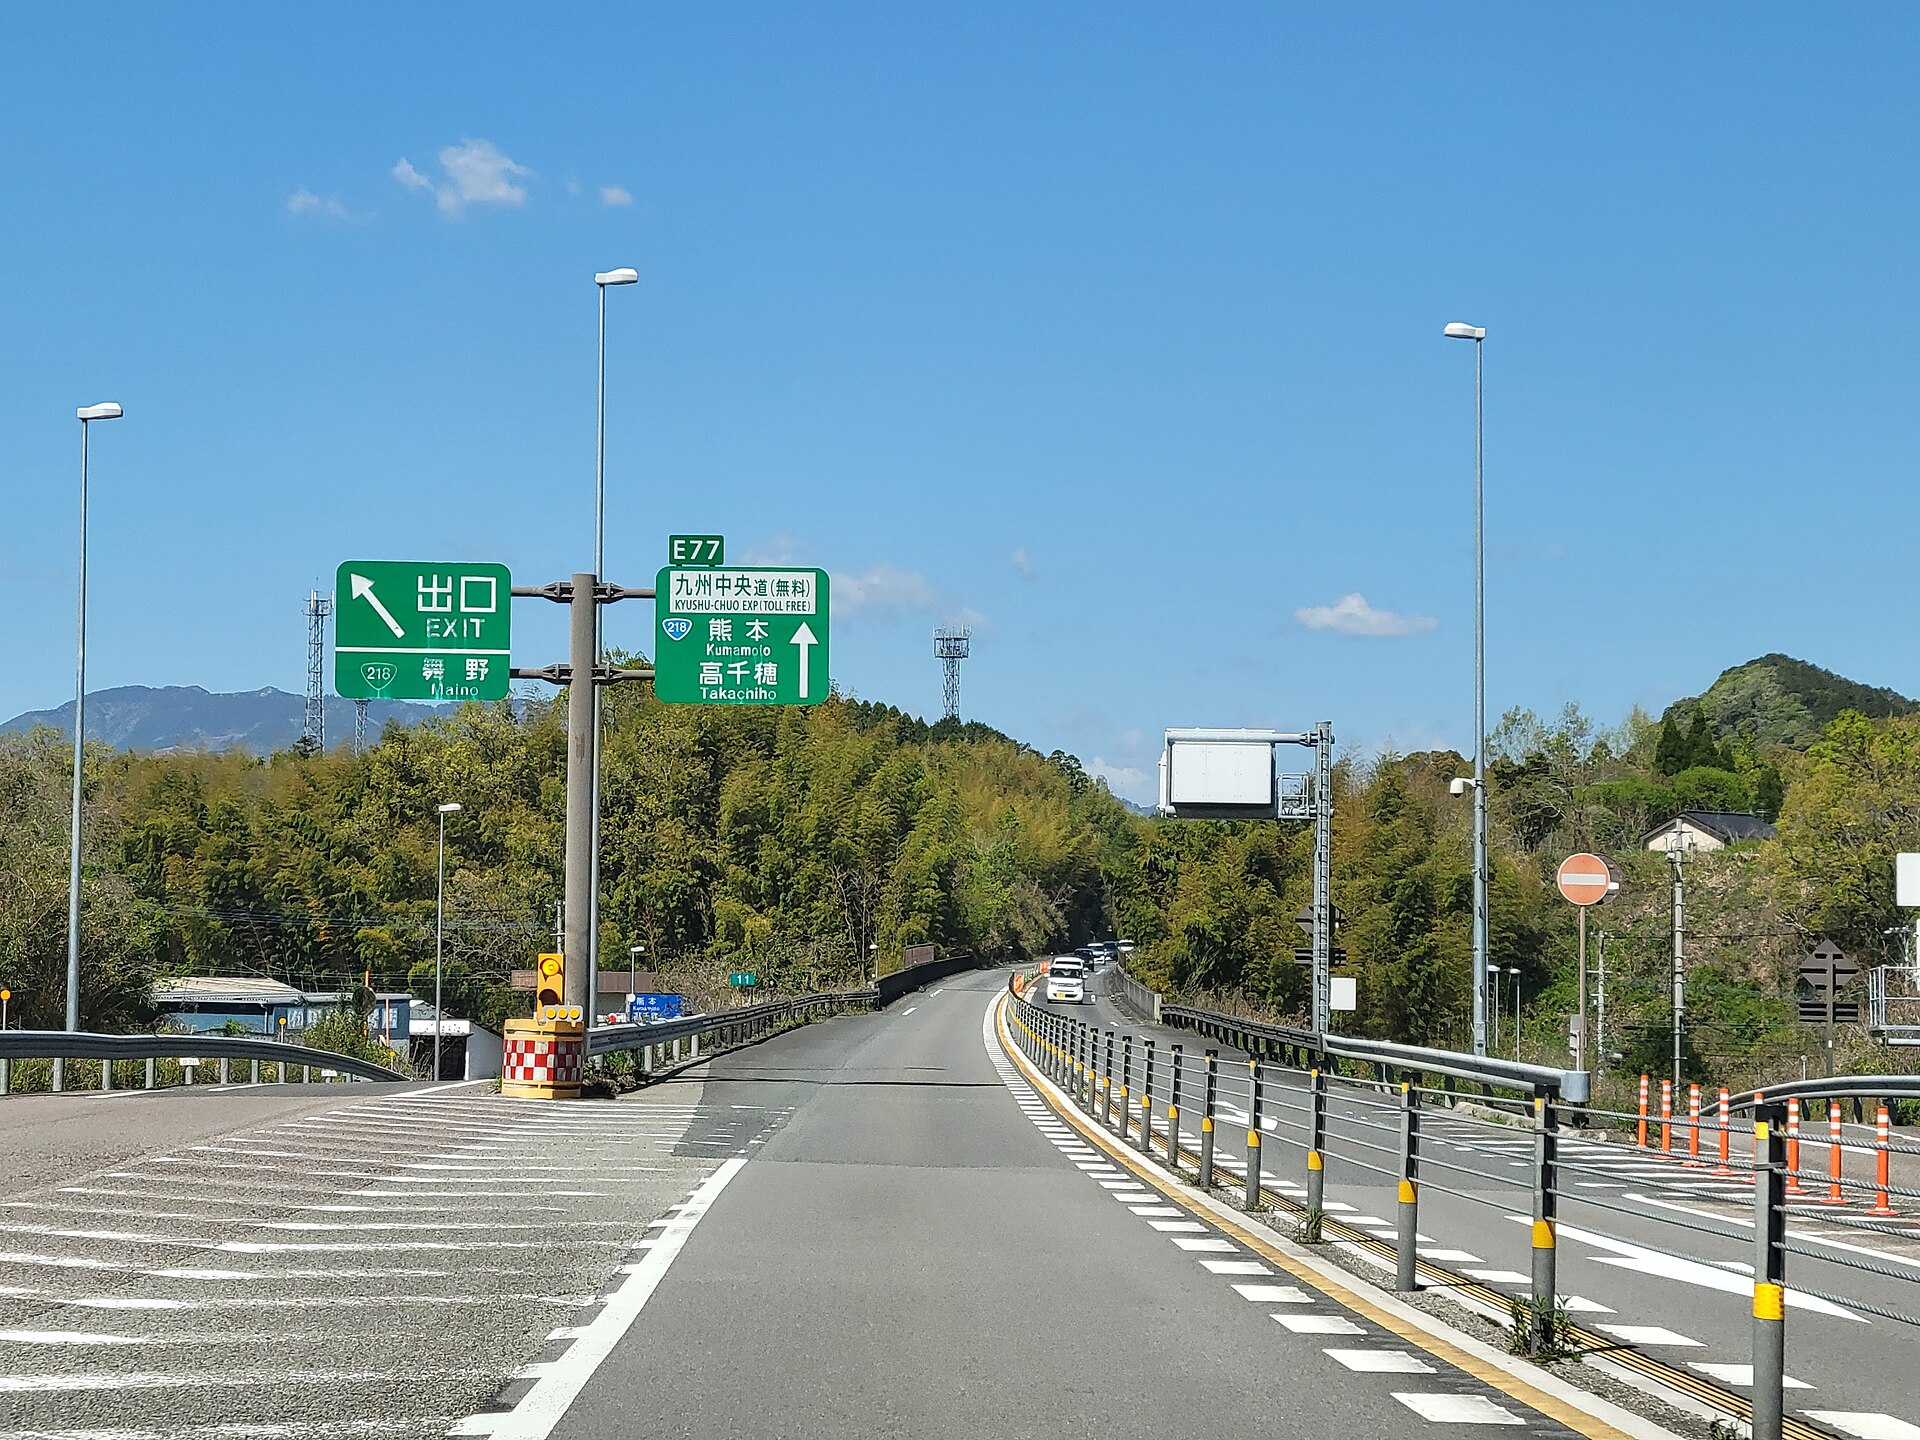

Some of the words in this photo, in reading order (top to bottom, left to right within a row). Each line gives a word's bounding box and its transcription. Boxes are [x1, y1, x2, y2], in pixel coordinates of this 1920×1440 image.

[673, 539, 720, 560] E77
[417, 574, 497, 613] 出口
[675, 573, 811, 598] 九州中央道(無料)
[675, 599, 740, 611] KYUSHU-CHUO
[786, 601, 811, 613] FREE)
[426, 617, 485, 638] EXIT
[667, 621, 687, 633] 218
[708, 617, 769, 642] 熊本
[706, 644, 771, 656] Kumamoto
[366, 666, 391, 680] 218
[422, 656, 489, 681] 舞野
[699, 660, 778, 685] 高千穂
[431, 683, 479, 696] Maino
[699, 686, 777, 700] Takachiho
[737, 974, 750, 985] 11
